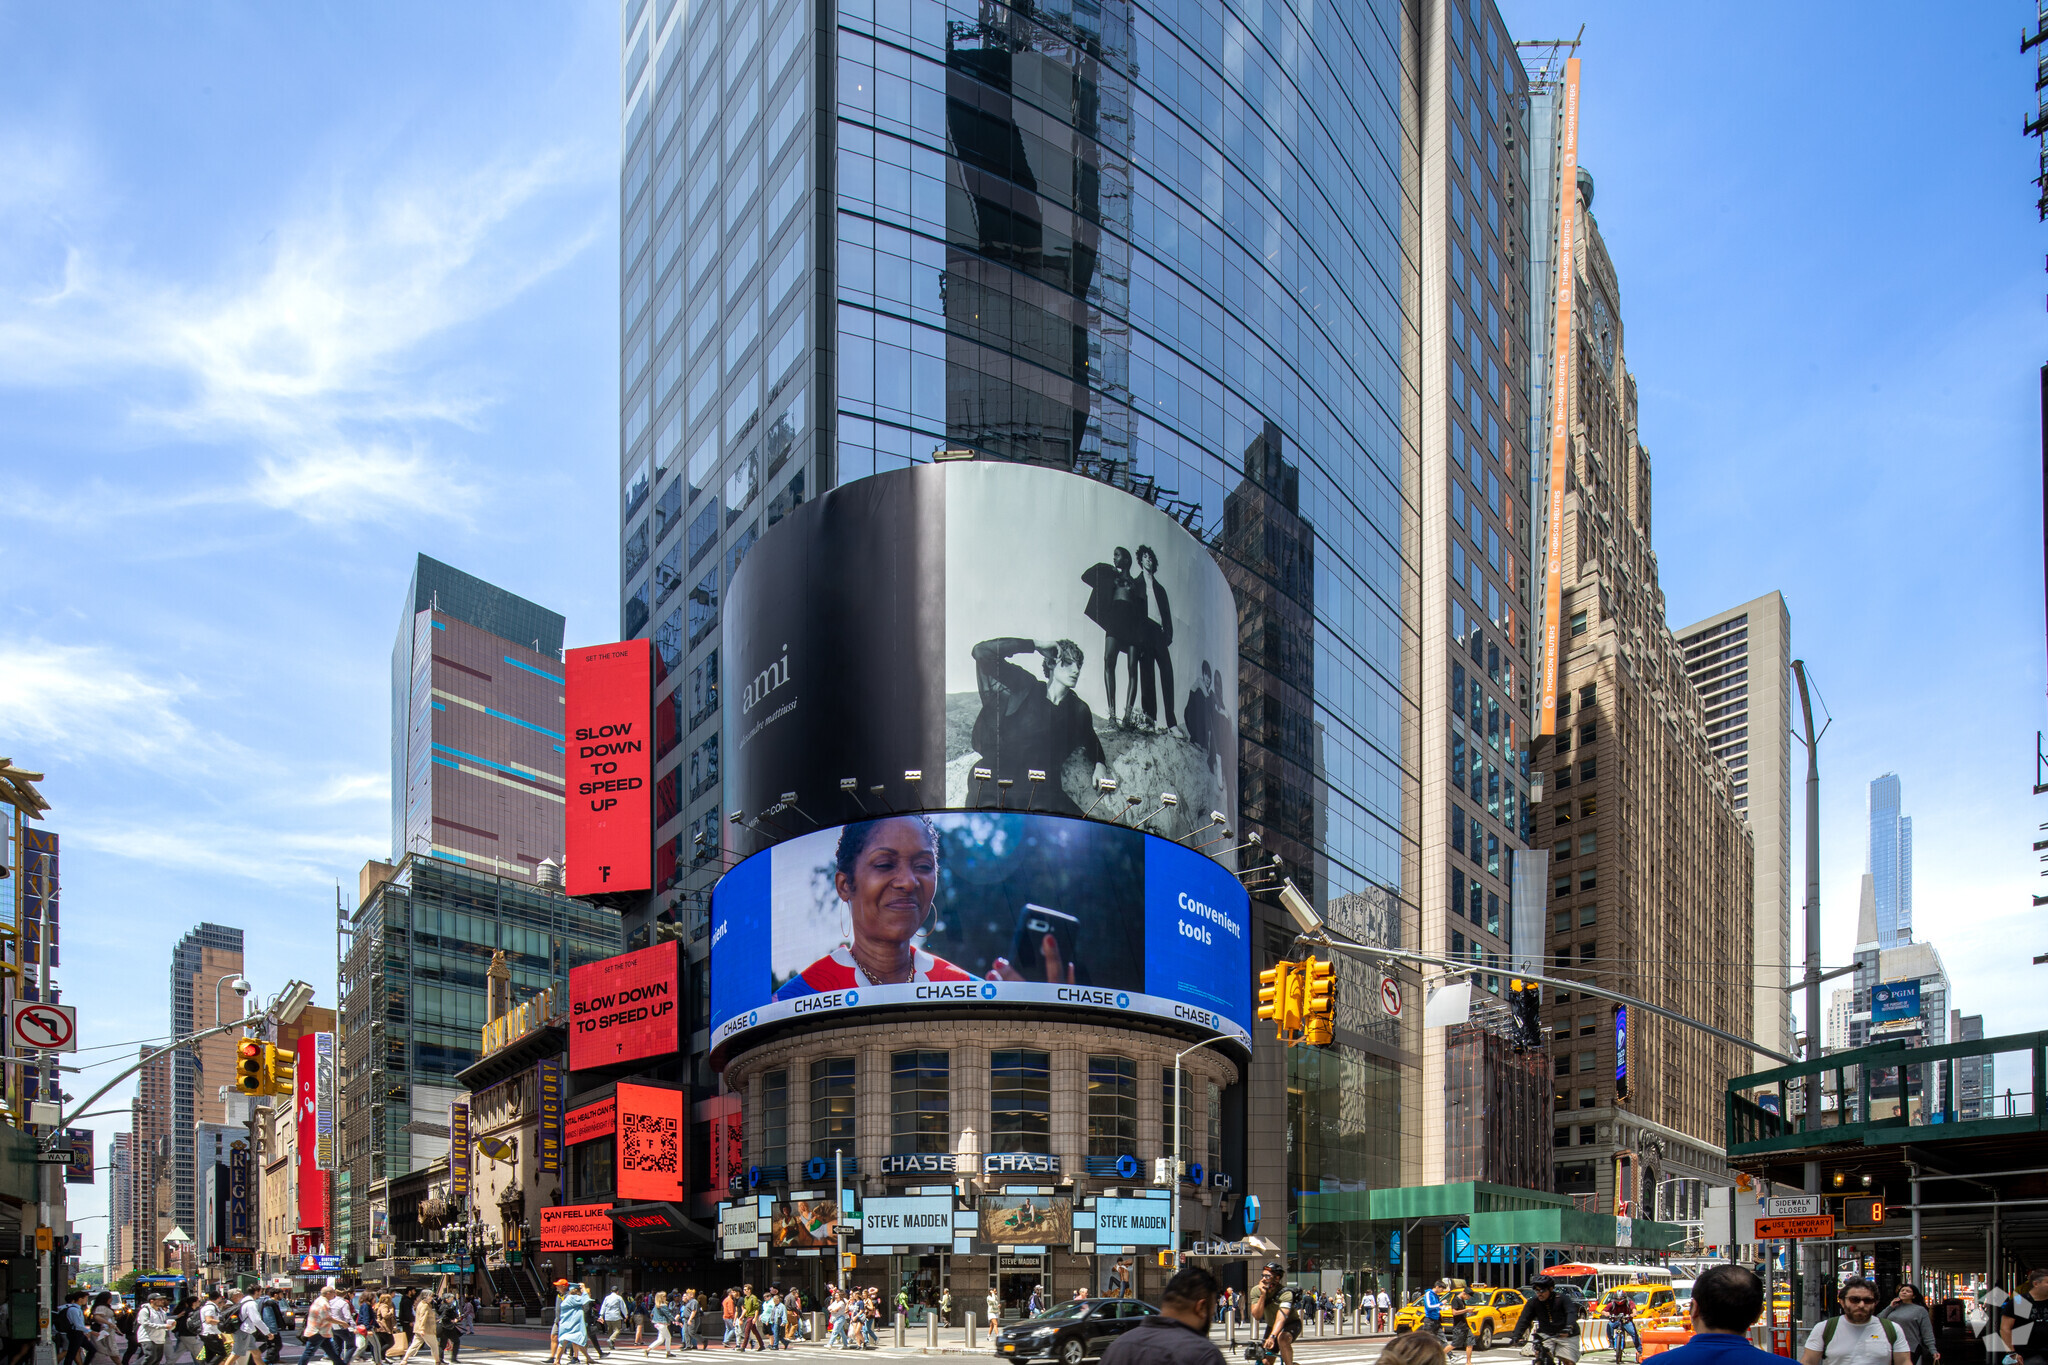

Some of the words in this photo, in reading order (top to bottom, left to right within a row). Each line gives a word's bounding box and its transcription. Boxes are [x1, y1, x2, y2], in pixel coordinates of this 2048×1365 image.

[1568, 83, 1576, 115] REUTERS
[1562, 252, 1570, 286] THOMSON
[1548, 625, 1556, 656] REUTERS
[585, 654, 597, 663] SET
[598, 652, 611, 661] THE
[611, 650, 629, 660] TONE
[742, 643, 790, 715] ami
[1546, 658, 1554, 692] THOMSON
[575, 722, 633, 741] SLOW
[580, 740, 642, 759] DOWN
[590, 761, 618, 776] TO
[579, 777, 643, 795] SPEED
[590, 798, 618, 812] UP
[1178, 892, 1240, 939] Convenient
[1178, 918, 1212, 946] tools
[604, 965, 613, 973] SET
[614, 962, 624, 971] THE
[624, 959, 638, 968] TONE
[574, 994, 616, 1016] SLOW
[618, 981, 668, 1005] DOWN
[916, 984, 977, 1000] CHASE
[1057, 988, 1114, 1006] CHASE
[1892, 988, 1915, 998] PGIM
[794, 994, 842, 1014] CHASE
[576, 1019, 596, 1034] TO
[598, 1006, 648, 1029] SPEED
[651, 1001, 674, 1018] UP
[1174, 1004, 1210, 1026] CHASE
[723, 1015, 748, 1037] CHASE
[482, 1016, 504, 1058] NEW
[544, 1064, 558, 1128] VICTORY
[578, 1110, 596, 1122] HEALTH
[596, 1106, 608, 1116] CAN
[454, 1106, 466, 1158] VICTORY
[544, 1138, 558, 1169] NEW
[880, 1155, 953, 1173] CHASE
[984, 1154, 1060, 1172] CHASE
[454, 1166, 466, 1192] NEW
[232, 1154, 245, 1229] REGAL
[1776, 1198, 1811, 1207] SIDEWALK
[1872, 1202, 1882, 1221] 8
[544, 1212, 562, 1220] CAN
[563, 1210, 583, 1218] FEEL
[584, 1208, 603, 1218] LIKE
[618, 1214, 671, 1228] Subway
[867, 1215, 900, 1228] STEVE
[903, 1214, 948, 1228] MADDEN
[1100, 1215, 1128, 1228] STEVE
[1130, 1216, 1166, 1229] MADDEN
[724, 1222, 738, 1236] STEVE
[738, 1220, 756, 1234] MADDEN
[1788, 1219, 1830, 1228] TEMPORARY
[566, 1238, 600, 1248] HEALTH
[1192, 1241, 1252, 1256] CHASE
[1018, 1258, 1040, 1266] MADDEN
